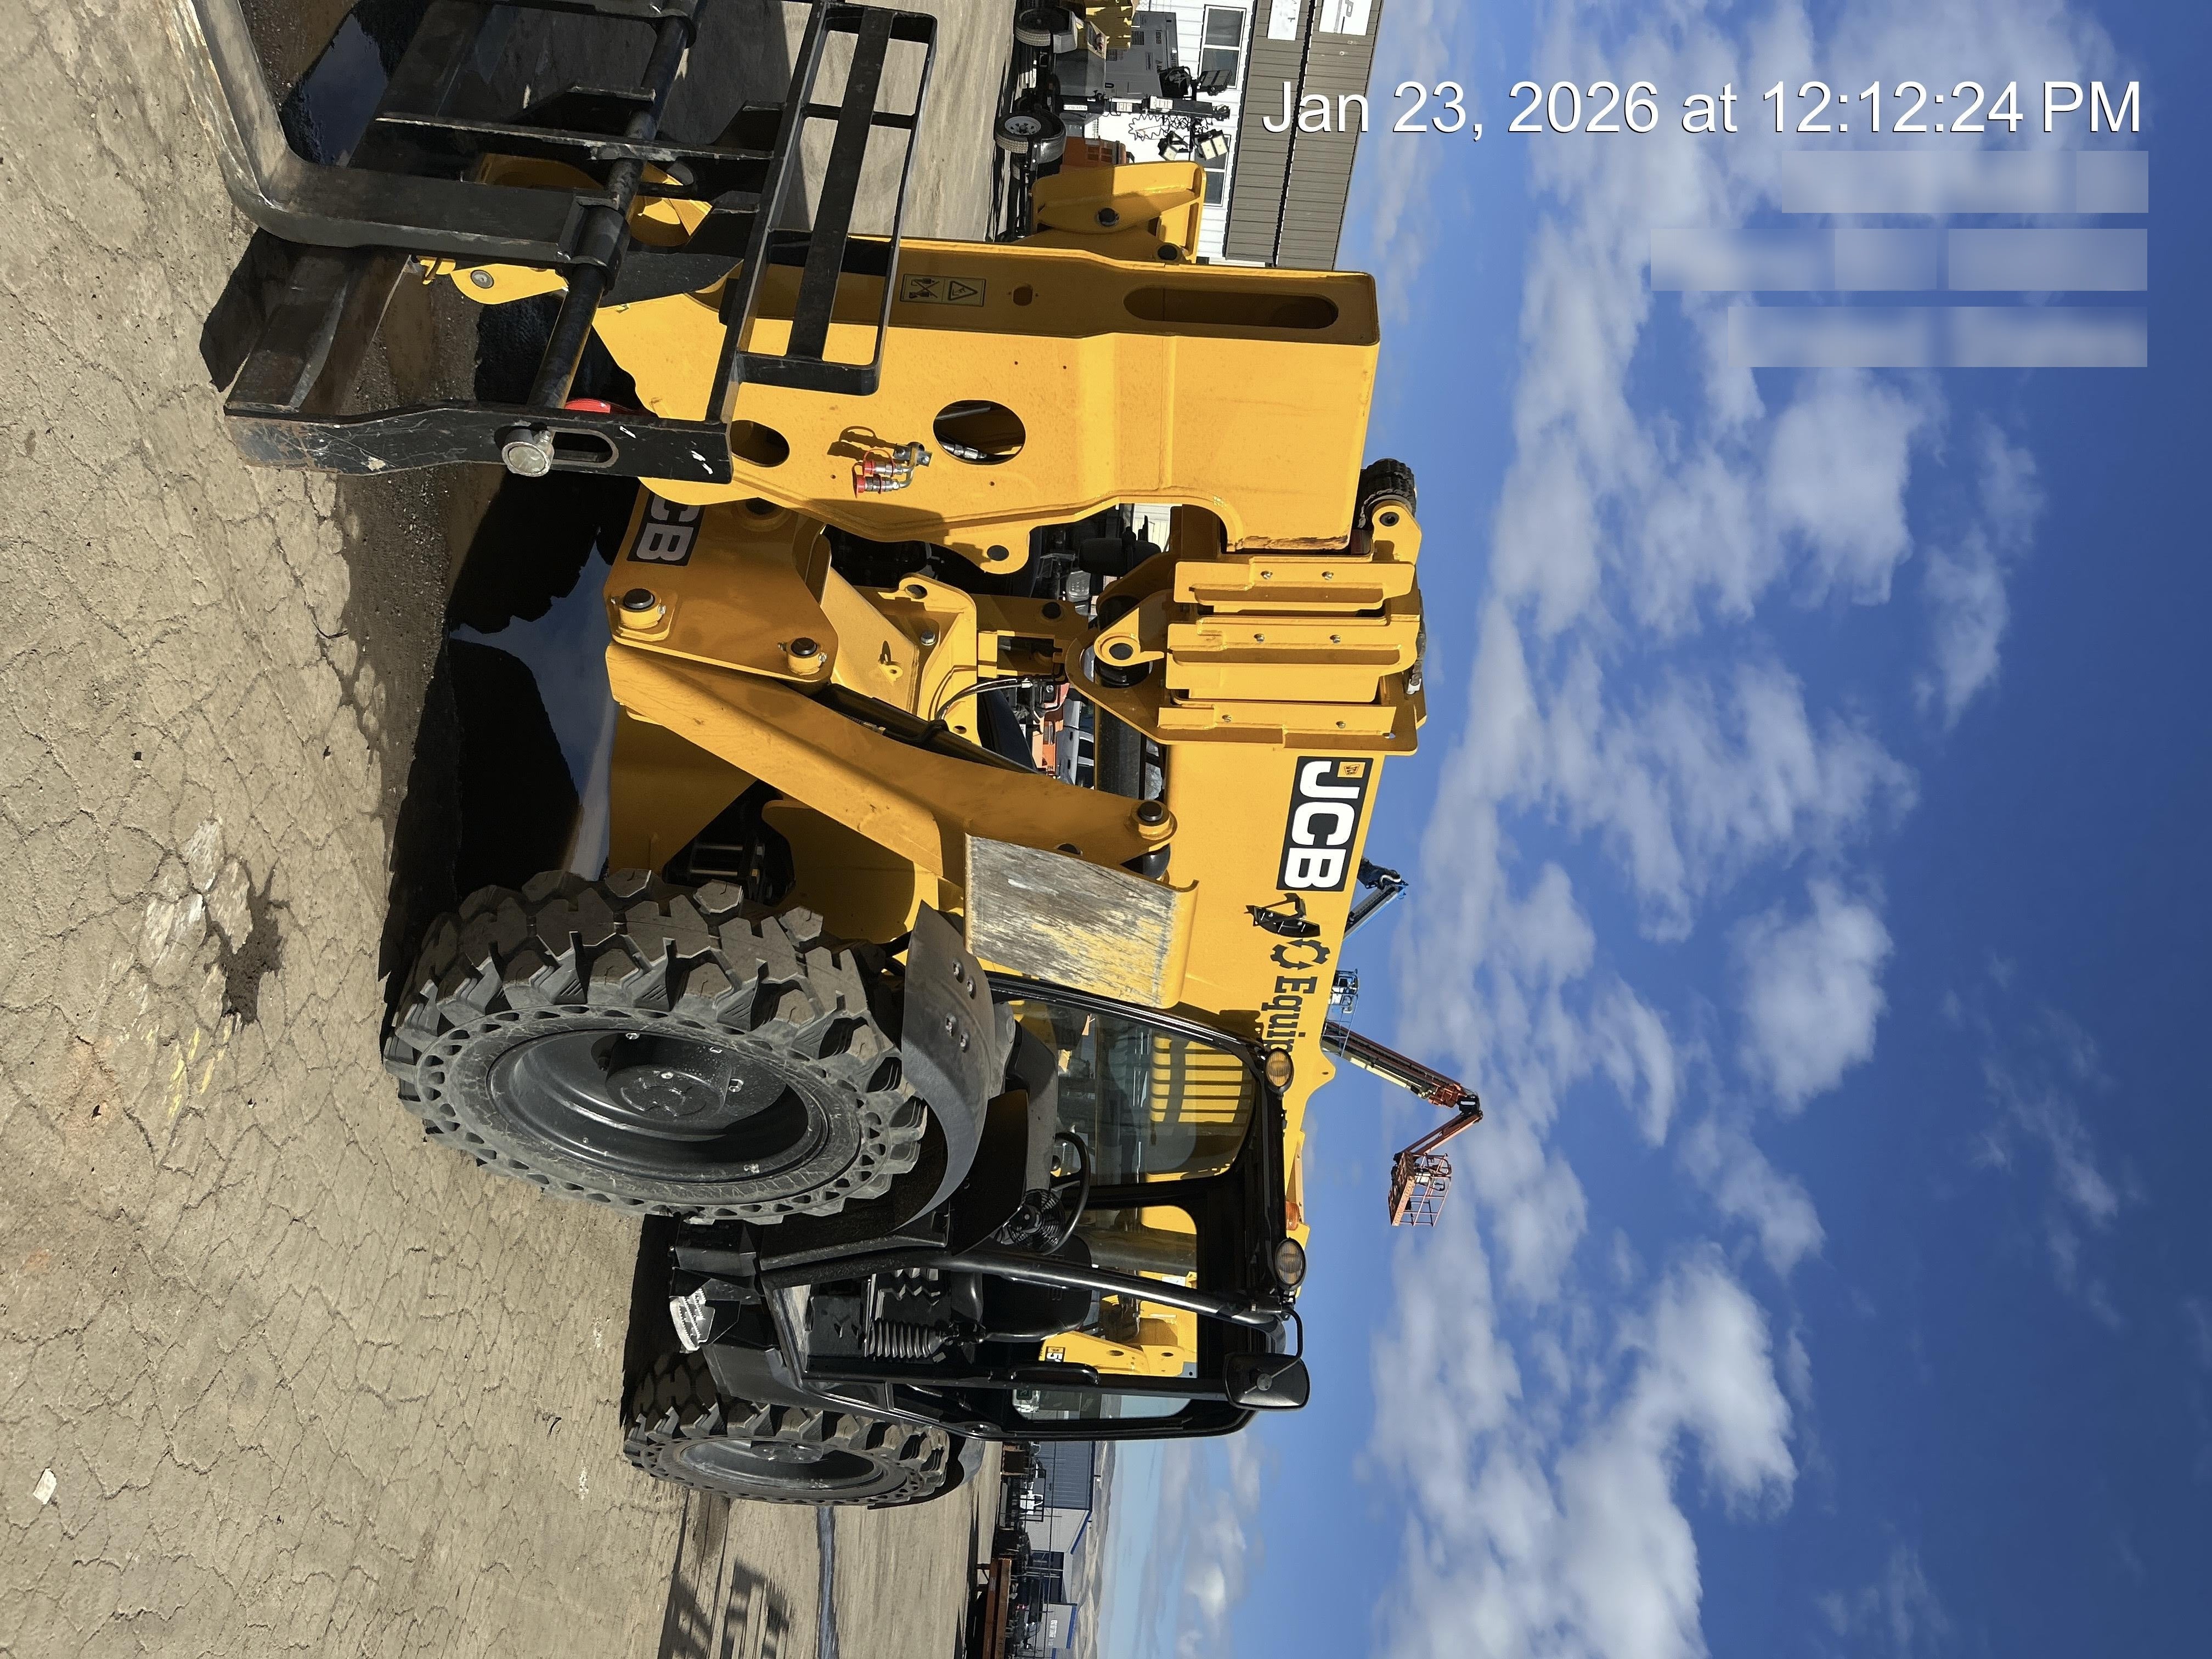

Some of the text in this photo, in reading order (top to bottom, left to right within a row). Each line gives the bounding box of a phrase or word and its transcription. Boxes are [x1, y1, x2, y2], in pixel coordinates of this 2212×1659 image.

[635, 494, 700, 562] CB
[1284, 760, 1360, 888] JCB
[1260, 975, 1318, 1054] Equip
